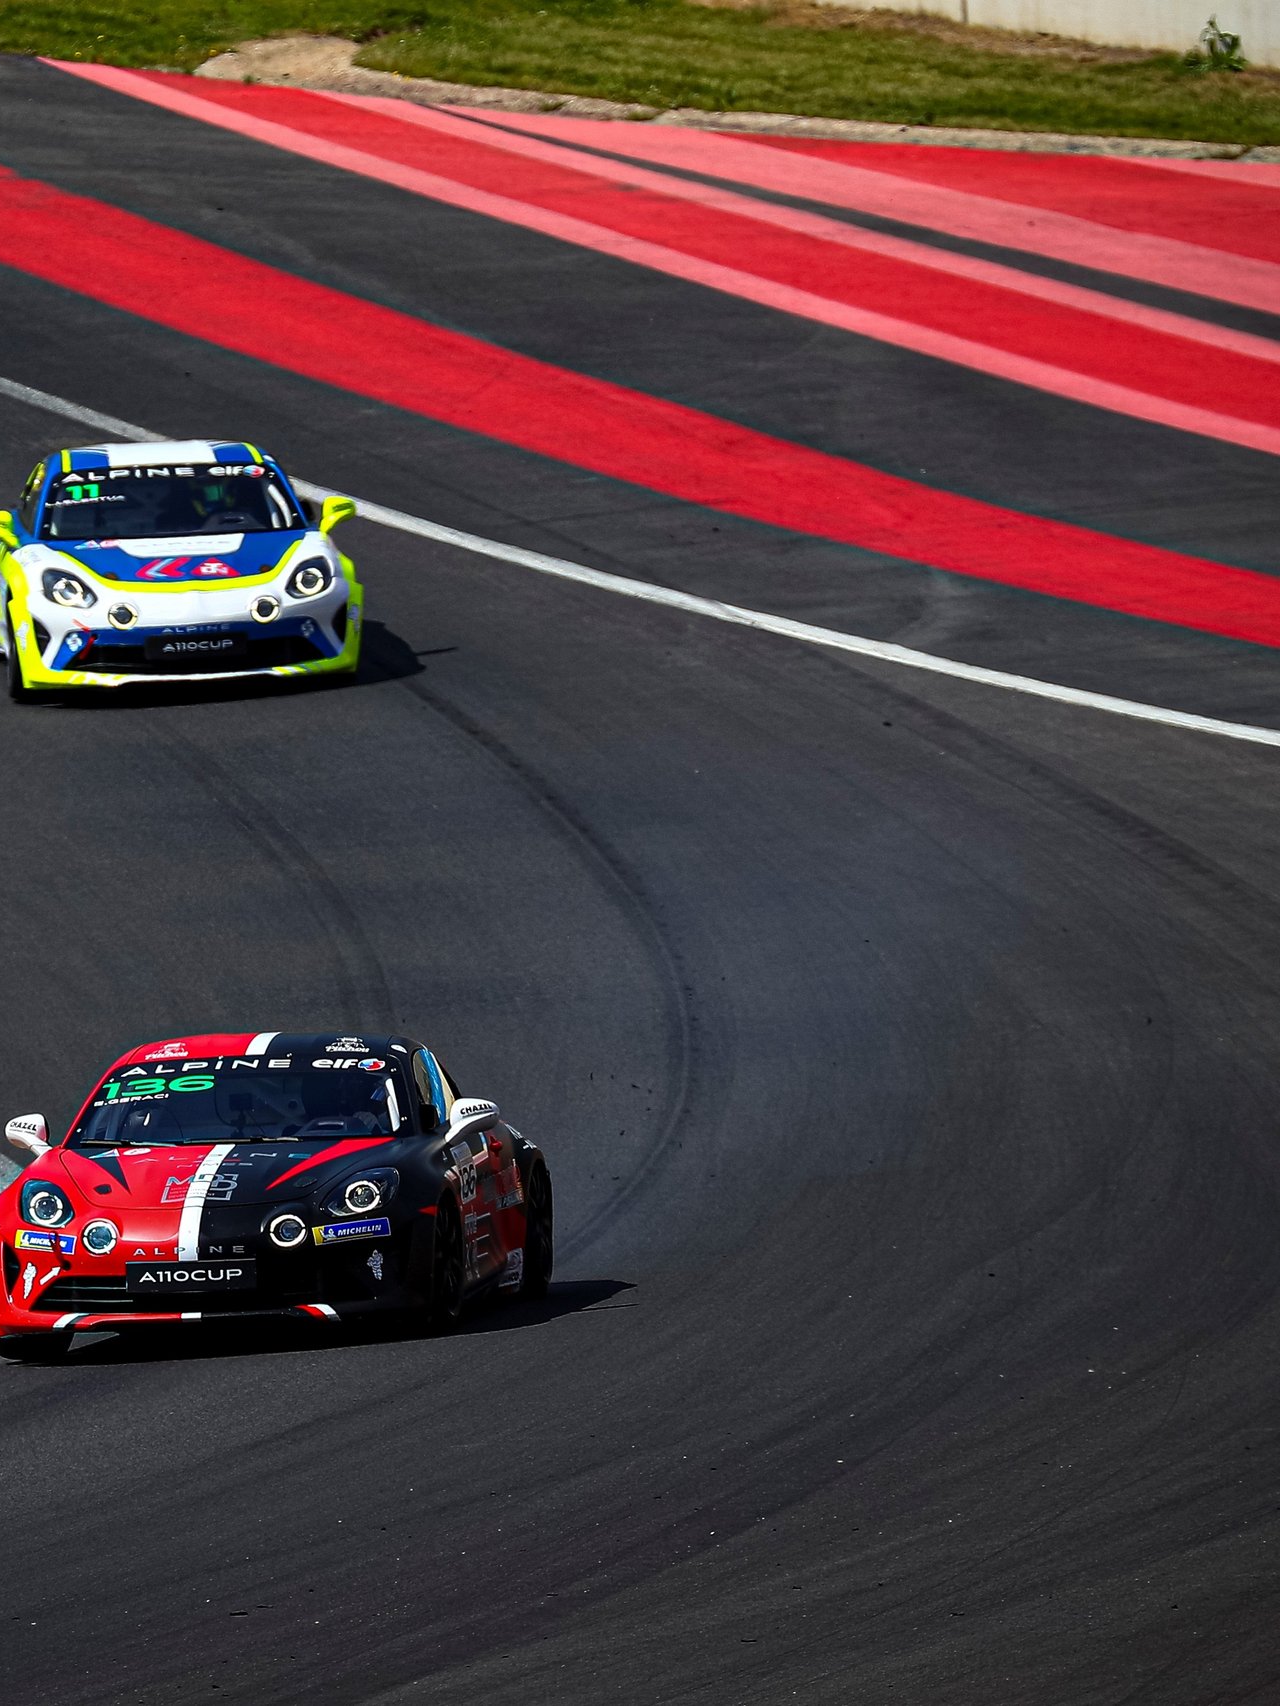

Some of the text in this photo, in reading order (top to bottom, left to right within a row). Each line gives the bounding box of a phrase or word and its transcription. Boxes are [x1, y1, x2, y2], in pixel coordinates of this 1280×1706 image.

[61, 466, 195, 484] ALPINE
[207, 465, 244, 476] elf
[66, 483, 99, 501] 11
[161, 623, 231, 633] ALPINE
[162, 639, 233, 653] A110CUP
[120, 1058, 292, 1078] ALPINE
[312, 1058, 360, 1069] elf
[102, 1075, 215, 1100] 136
[460, 1103, 493, 1115] CHAZEL
[10, 1121, 37, 1131] CHAZEL
[337, 1224, 382, 1237] MICHELIN
[133, 1245, 245, 1256] ALPINE
[139, 1268, 242, 1283] A110CUP
